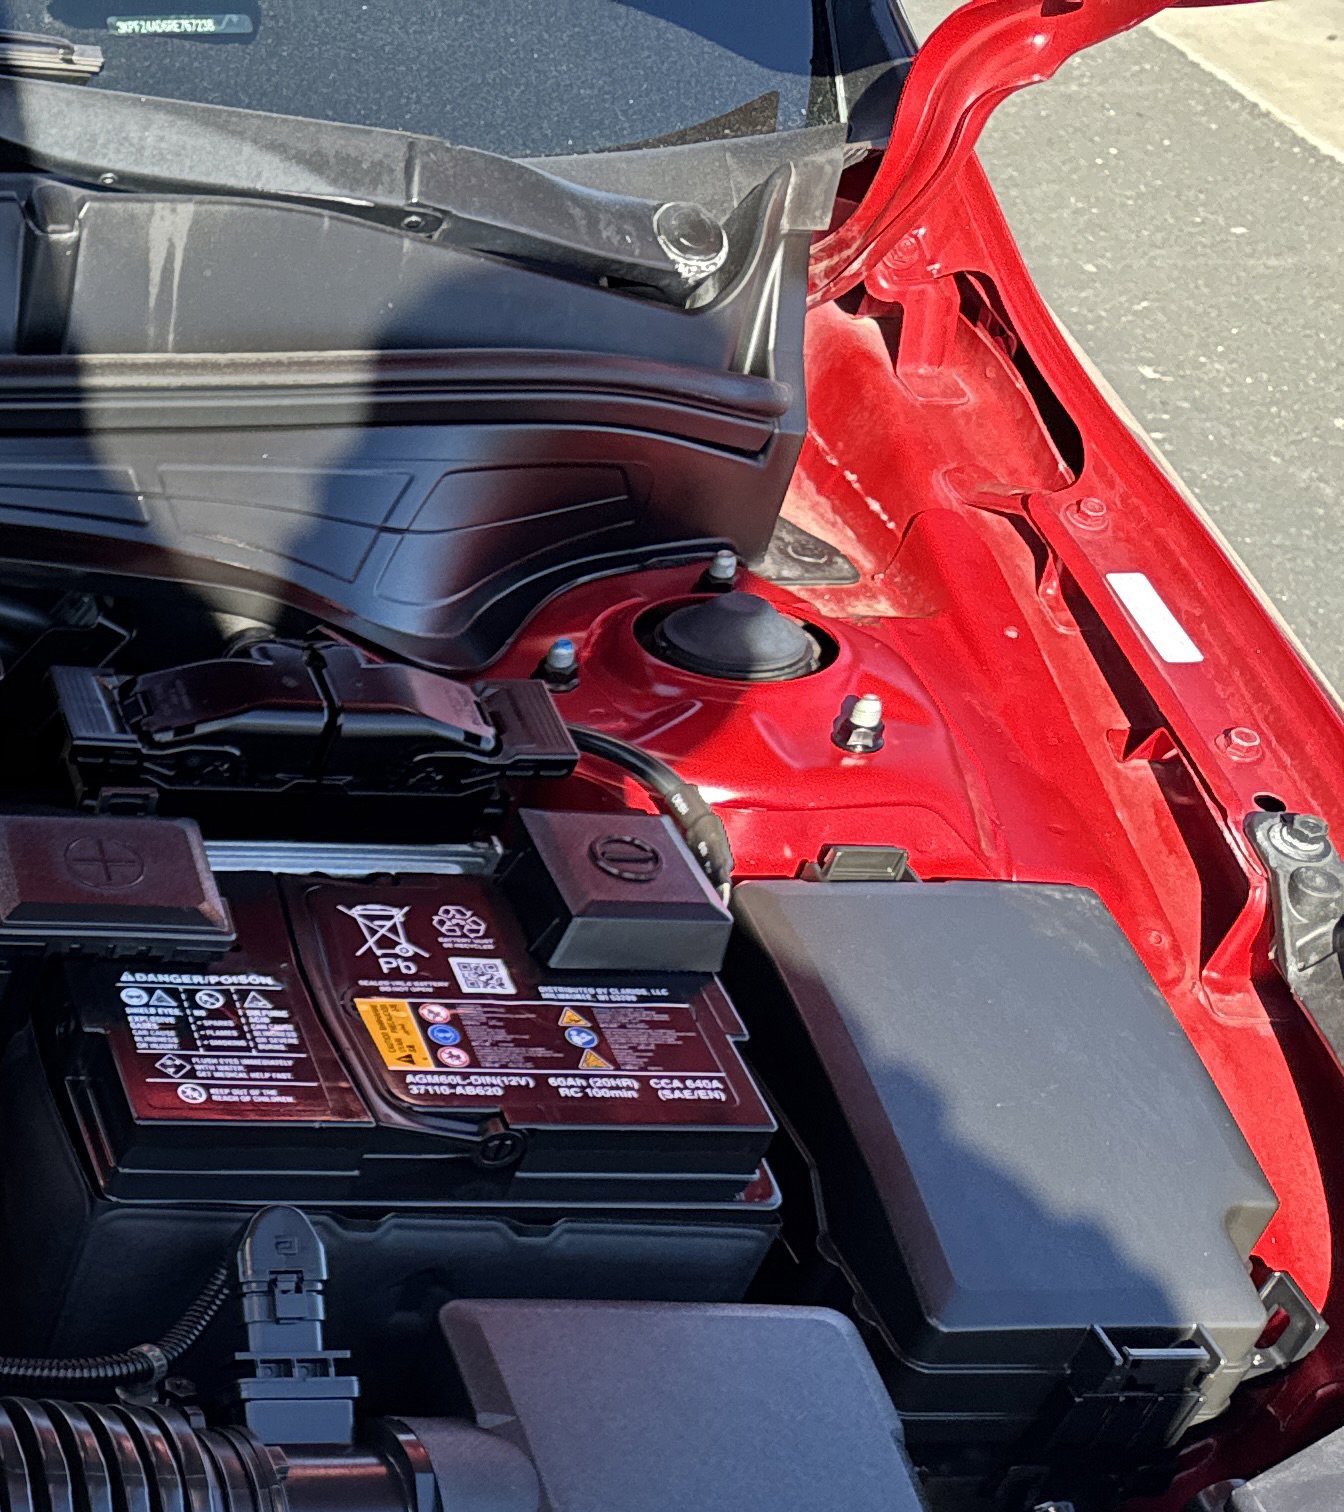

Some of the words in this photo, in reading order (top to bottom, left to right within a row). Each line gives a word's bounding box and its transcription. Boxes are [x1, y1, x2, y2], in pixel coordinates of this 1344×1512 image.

[378, 957, 417, 974] Pb
[134, 973, 275, 986] DANGER/POISON
[595, 987, 608, 995] BY
[191, 1057, 218, 1065] FLUSH
[548, 1077, 587, 1087] 60Ah
[589, 1077, 641, 1090] (20HR)
[650, 1078, 683, 1089] CCA
[685, 1078, 724, 1089] 640A
[408, 1084, 505, 1096] 37110-AB620
[558, 1087, 583, 1097] RC
[586, 1087, 639, 1099] 100min
[658, 1089, 727, 1101] (SAE/EN)
